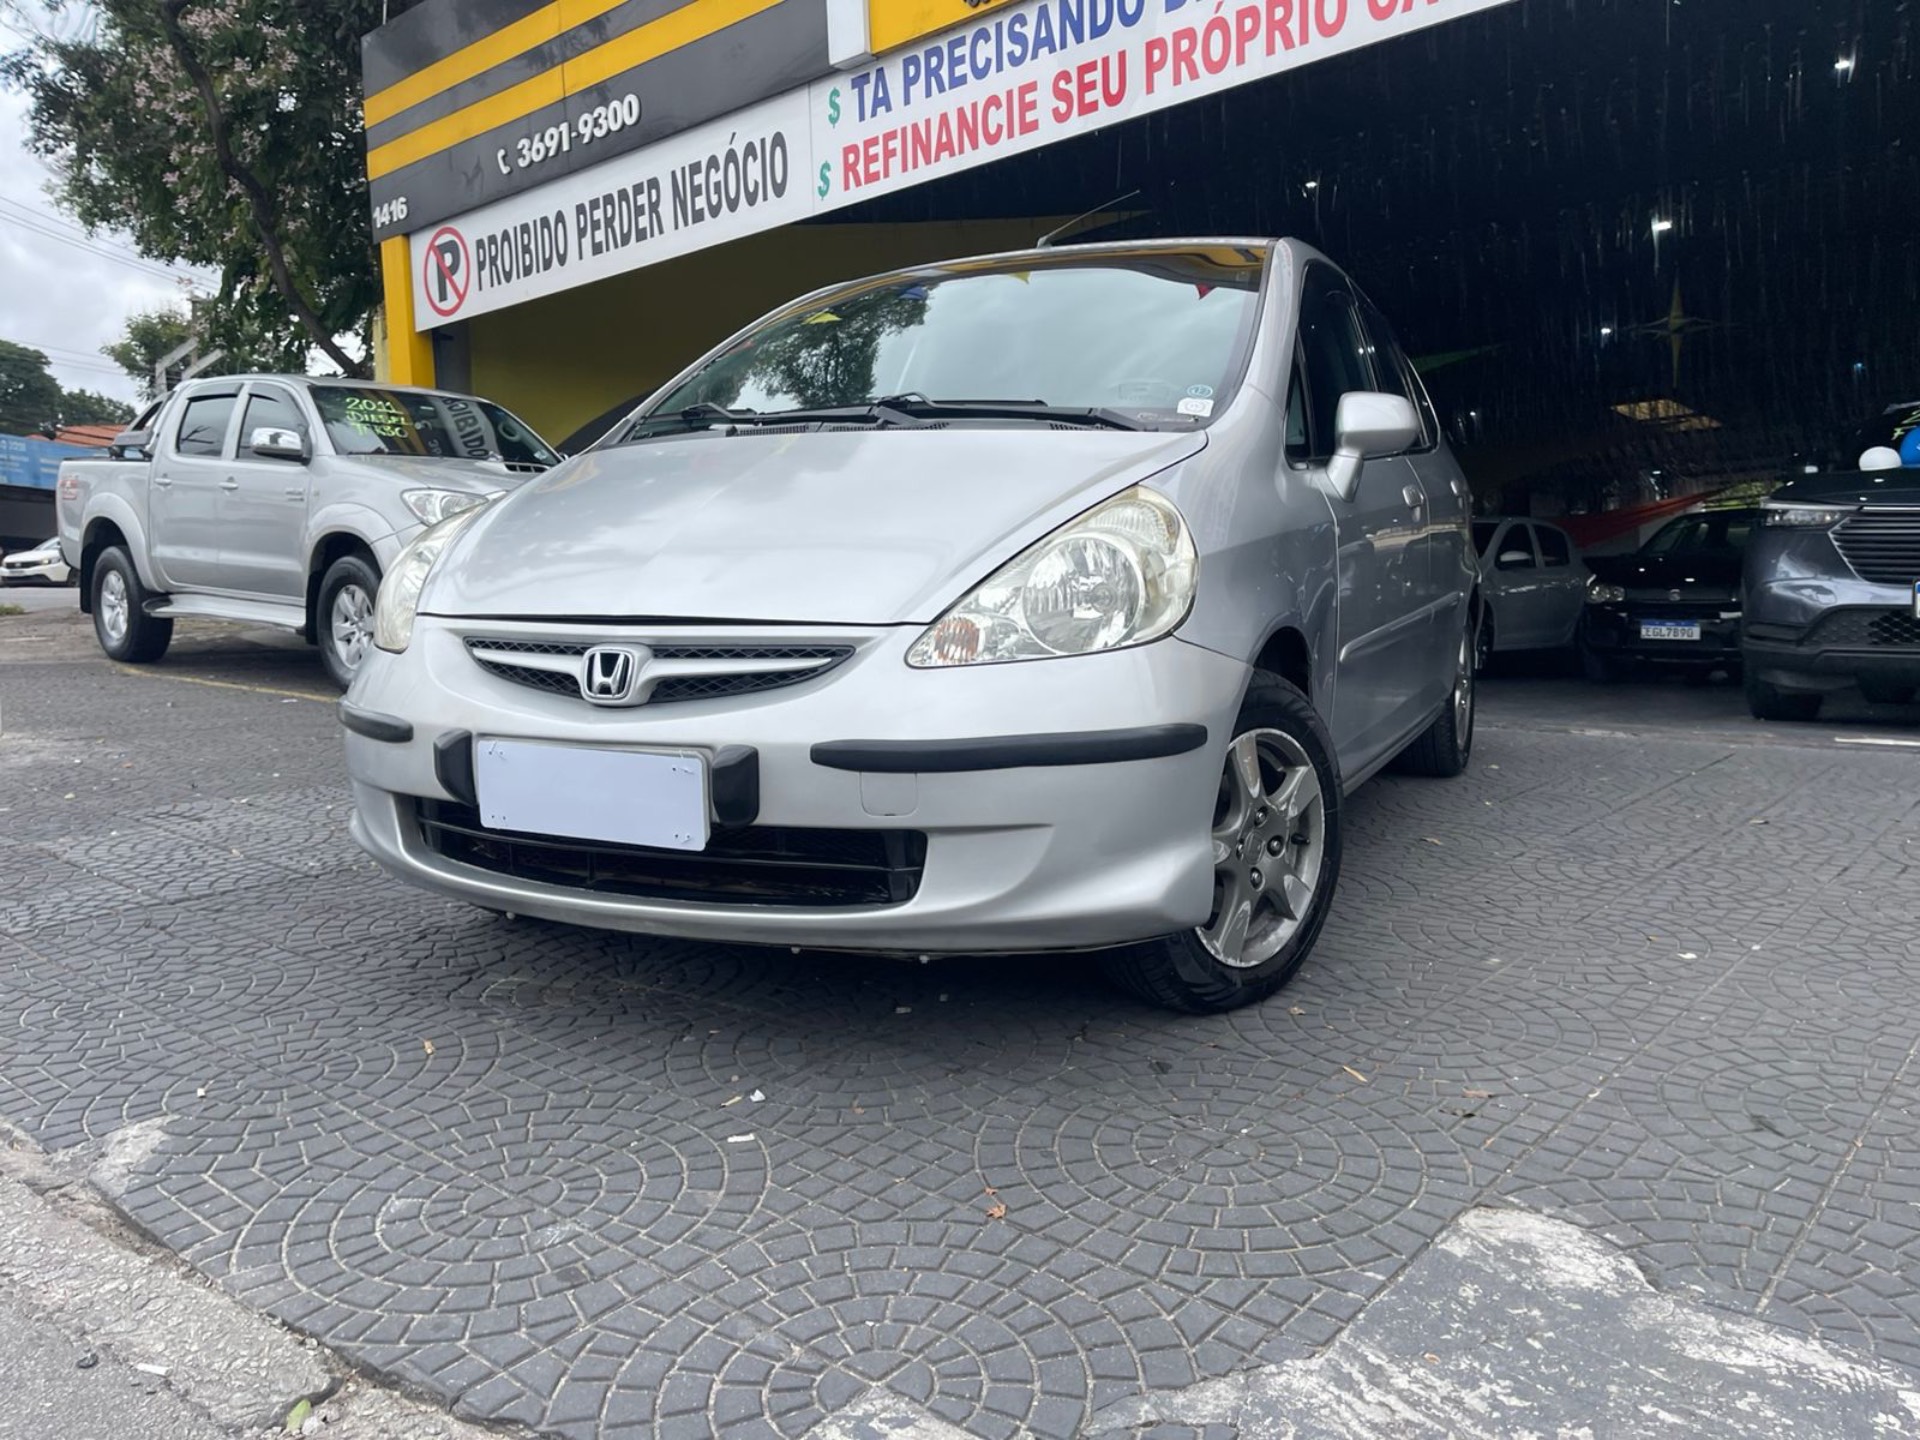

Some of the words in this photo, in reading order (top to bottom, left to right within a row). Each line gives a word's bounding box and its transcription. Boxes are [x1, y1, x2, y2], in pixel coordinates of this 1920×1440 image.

[842, 80, 1040, 192] REFINANCIE
[1051, 49, 1127, 125] SEU
[1145, 0, 1348, 96] PRÓPRIO
[851, 66, 893, 123] TA
[516, 93, 640, 168] 3691-9300
[372, 196, 408, 229] 1416
[475, 209, 568, 291] PROIBIDO
[575, 176, 664, 260] PERDER
[671, 131, 788, 231] NEGÓCIO
[345, 396, 404, 415] 2011
